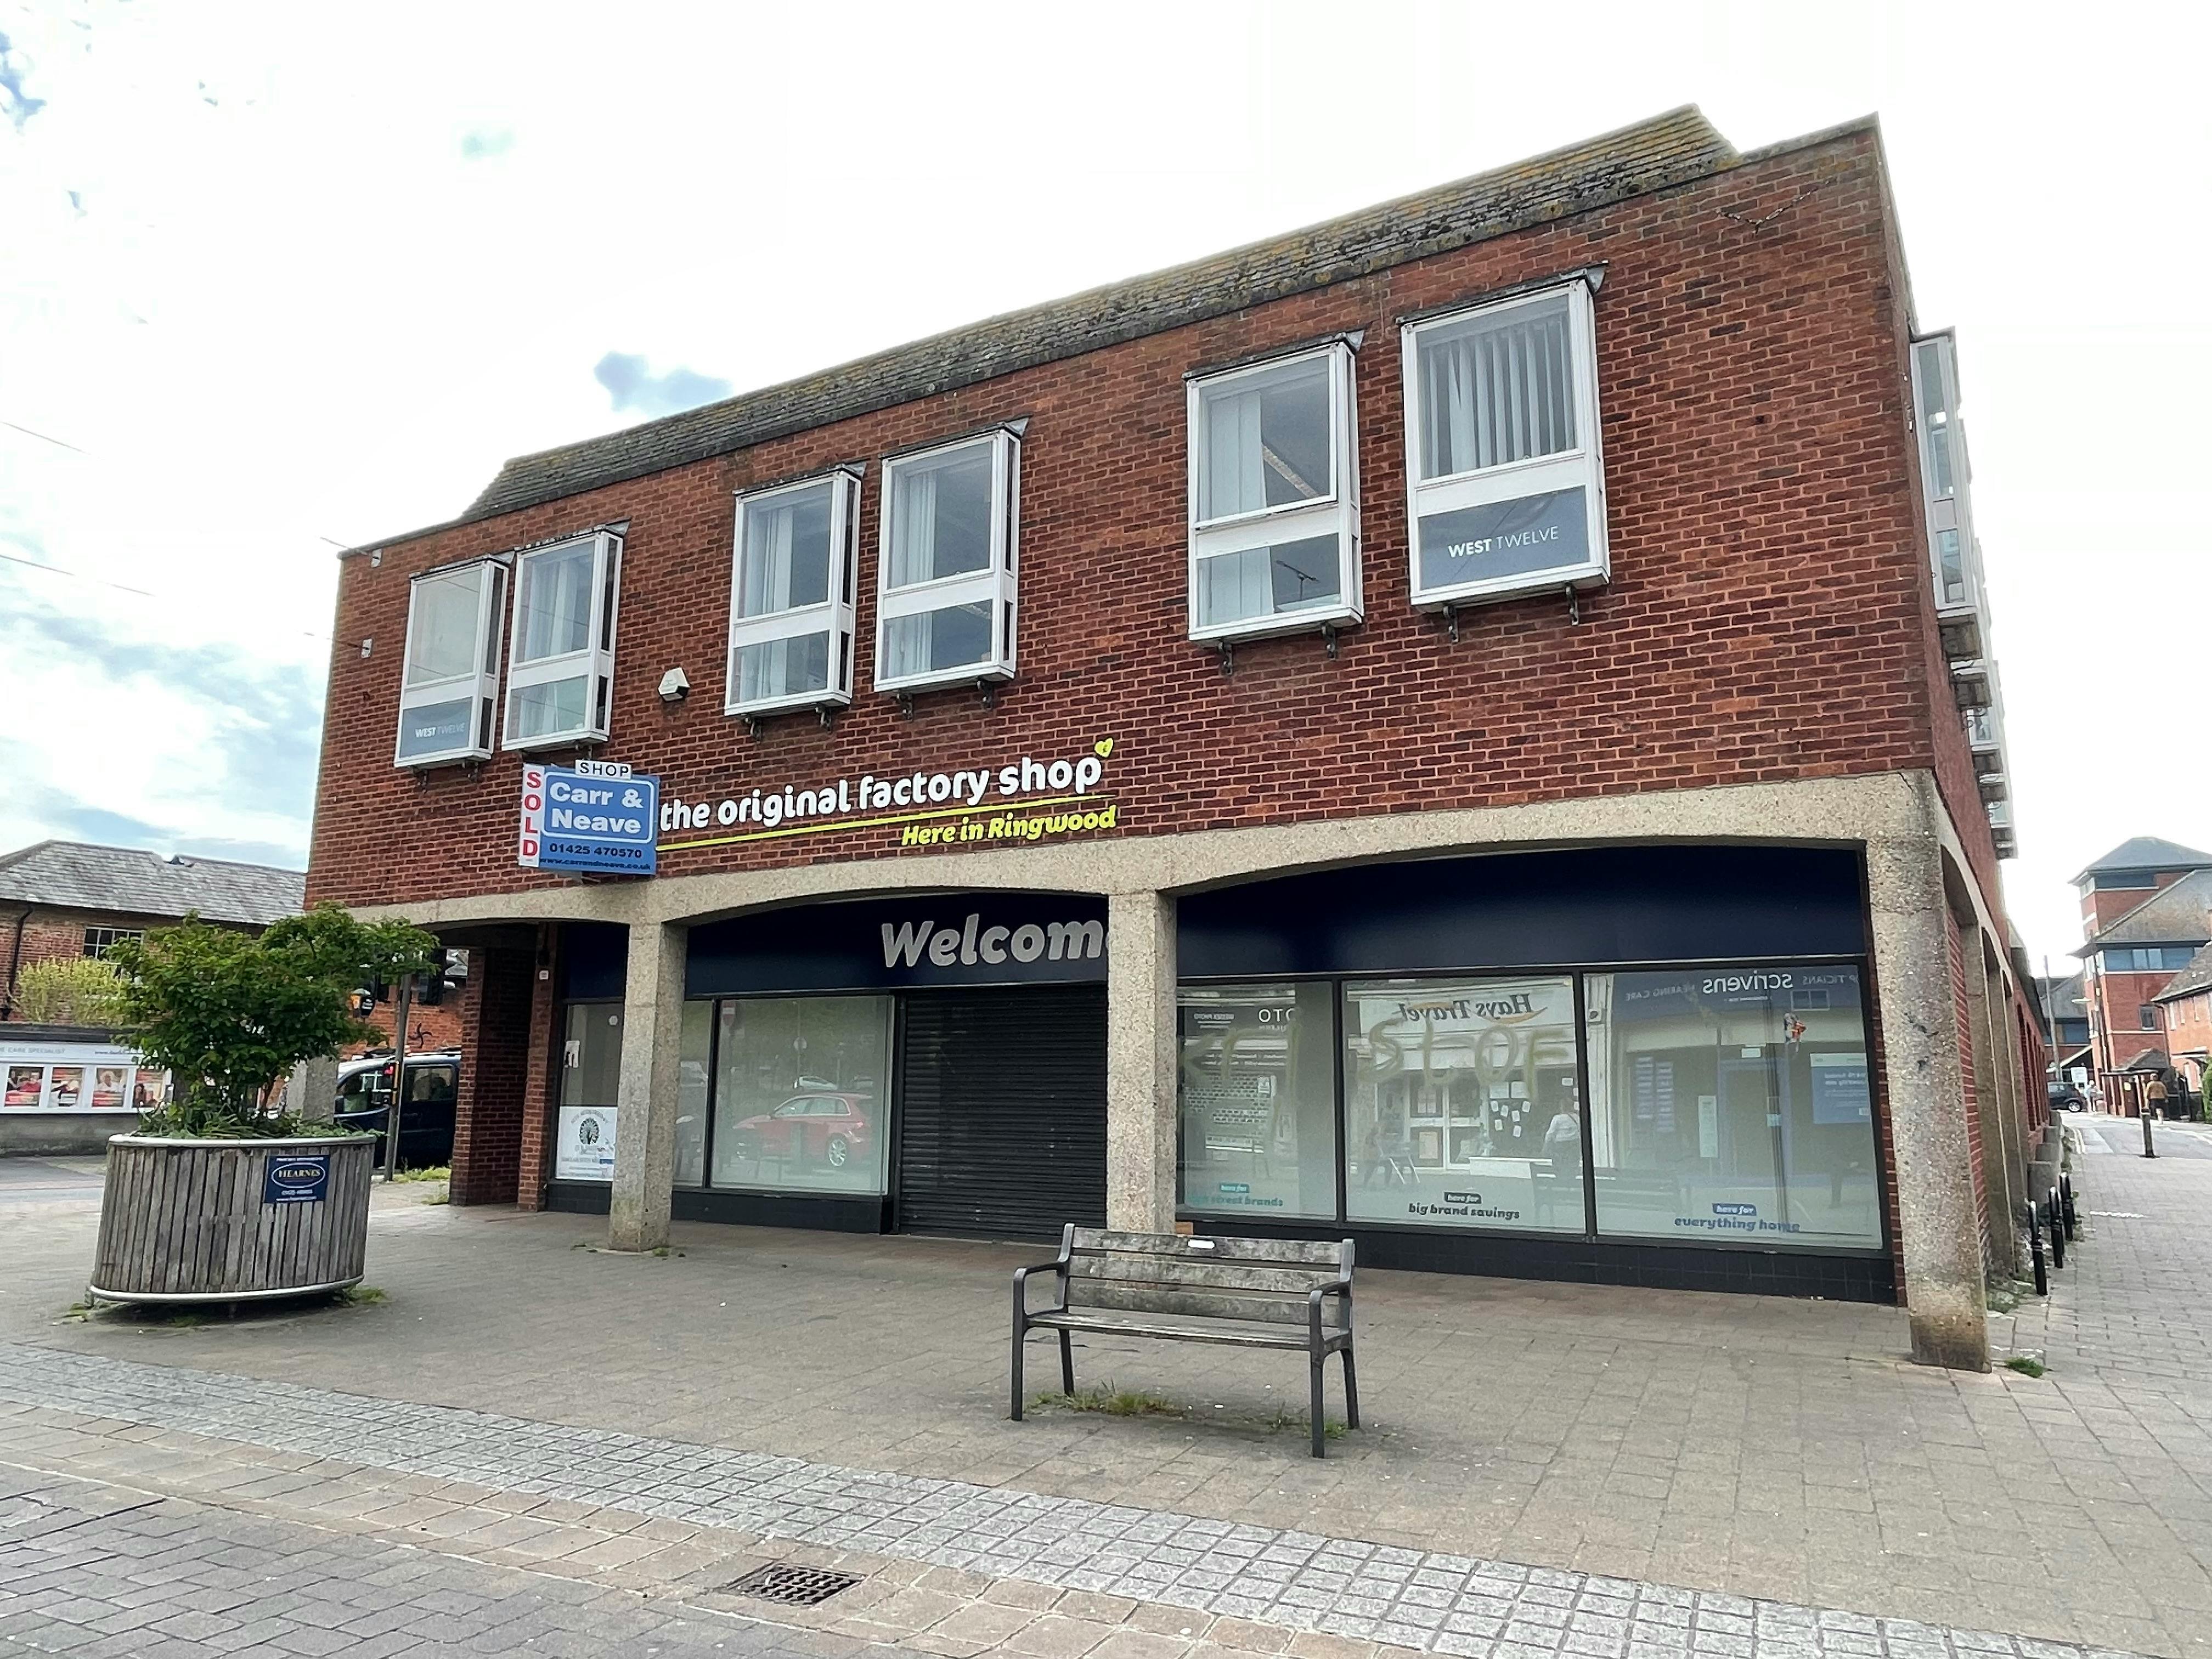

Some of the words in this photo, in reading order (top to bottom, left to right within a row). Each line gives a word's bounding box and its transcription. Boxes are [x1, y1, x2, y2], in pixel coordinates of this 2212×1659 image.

[1448, 538, 1492, 558] WEST
[1496, 526, 1559, 550] TWELVE
[415, 726, 437, 738] WEST
[438, 722, 466, 735] TWELVE
[579, 762, 629, 777] SHOP
[550, 781, 614, 806] Carr
[621, 788, 645, 809] &
[660, 799, 711, 832] the
[718, 778, 851, 827] original
[859, 769, 990, 810] factory
[999, 756, 1102, 795] shop
[522, 771, 541, 857] SOLD
[551, 808, 642, 834] Neave
[901, 825, 955, 846] Here
[960, 816, 984, 840] in
[988, 805, 1117, 840] Ringwood
[550, 843, 590, 855] 01425
[594, 848, 642, 858] 470570
[881, 913, 1109, 968] Welcom
[279, 1169, 320, 1177] HEARNES
[1244, 1196, 1284, 1207] brands
[1716, 1205, 1738, 1214] here
[1738, 1206, 1754, 1215] for
[1408, 1202, 1429, 1216] big
[1430, 1204, 1468, 1216] brand
[1470, 1206, 1520, 1220] savings
[1674, 1217, 1757, 1232] everything
[1759, 1219, 1801, 1233] home
